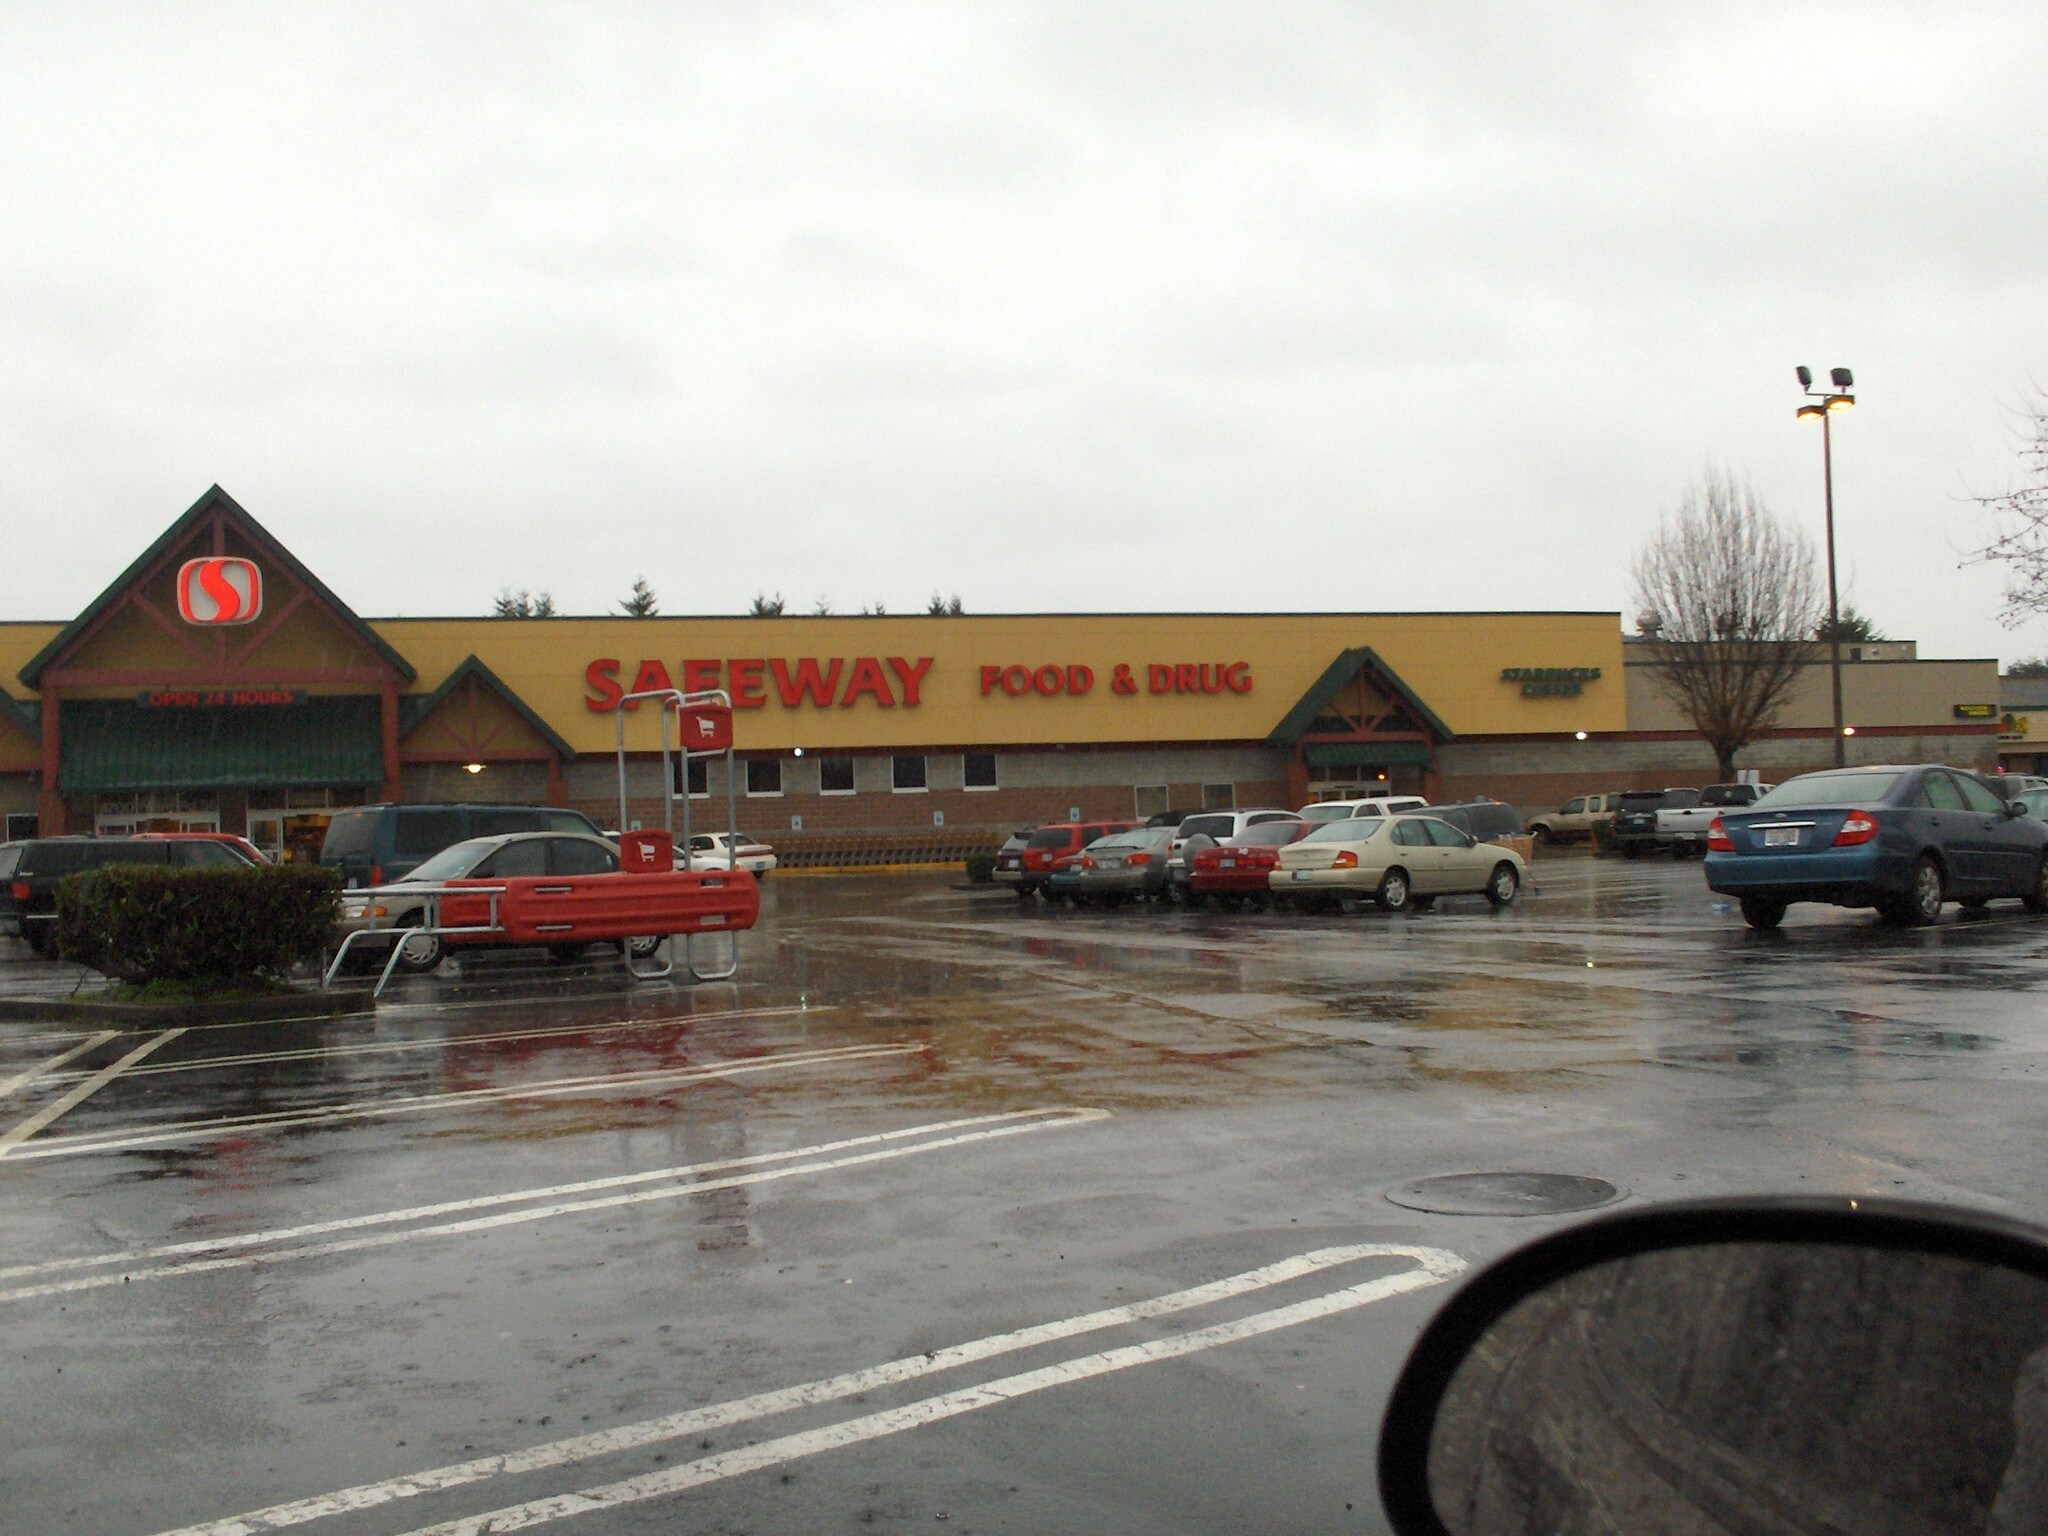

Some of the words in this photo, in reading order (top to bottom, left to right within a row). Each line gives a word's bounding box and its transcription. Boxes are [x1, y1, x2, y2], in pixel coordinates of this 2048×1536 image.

[149, 691, 199, 706] OPEN
[204, 691, 225, 705] 24
[231, 690, 294, 705] HOURS
[585, 657, 935, 711] SAFEWAY
[980, 664, 1095, 696] FOOD
[1111, 663, 1139, 694] &
[1148, 661, 1253, 694] DRUG
